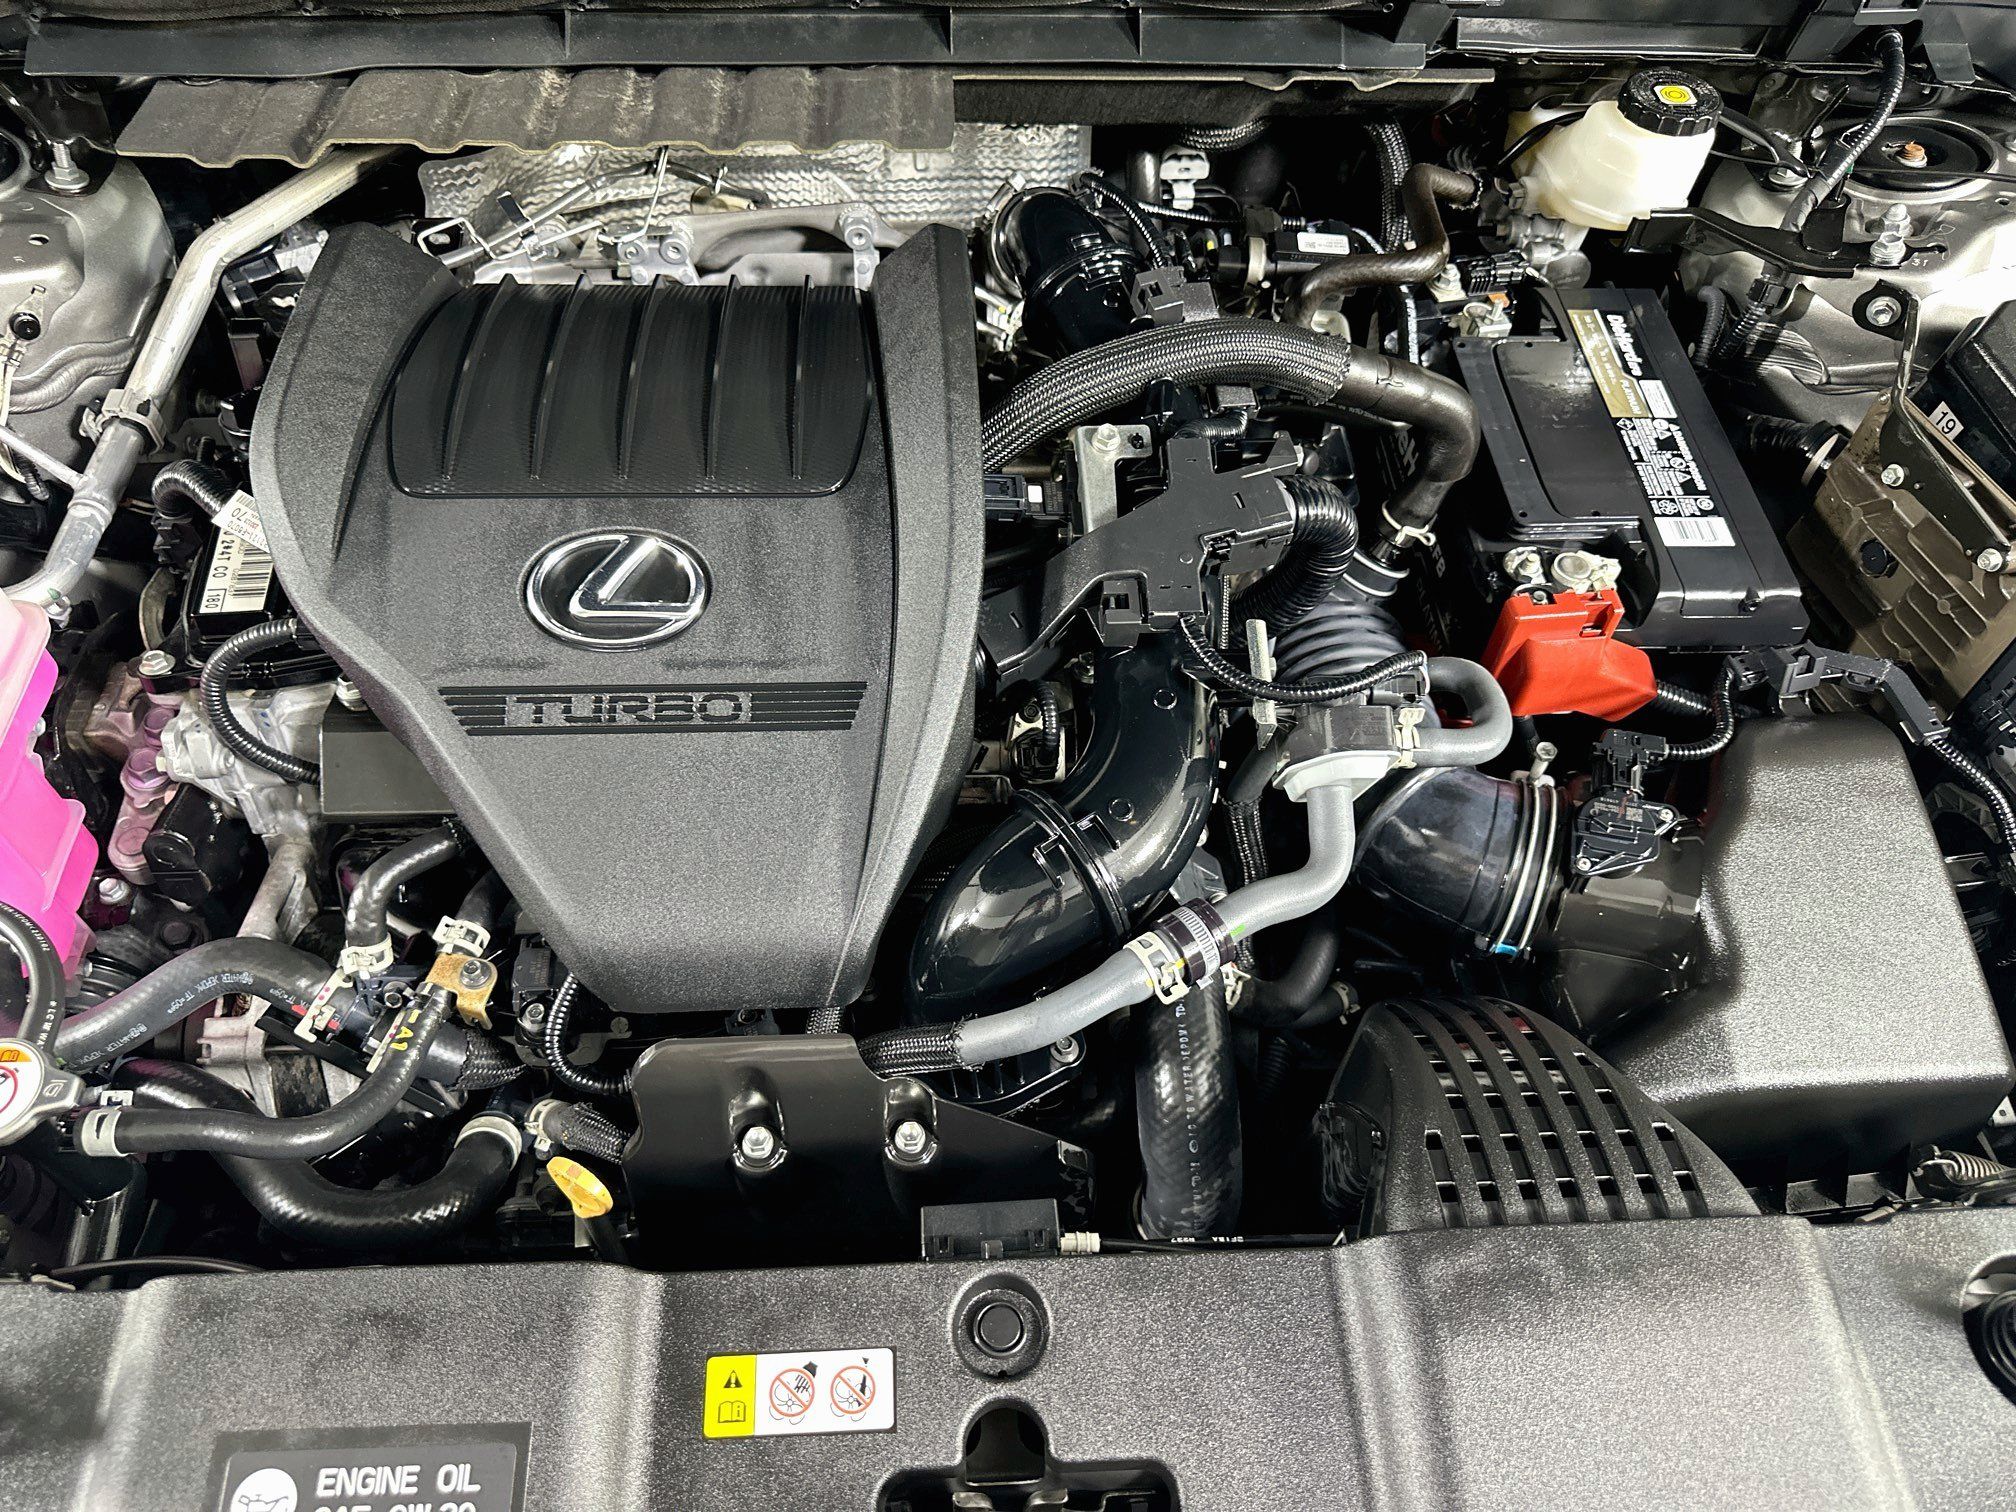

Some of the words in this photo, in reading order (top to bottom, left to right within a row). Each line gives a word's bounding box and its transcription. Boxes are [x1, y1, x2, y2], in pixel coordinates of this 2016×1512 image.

[1620, 379, 1642, 415] PLATINUM
[1935, 410, 1957, 435] 19
[515, 693, 742, 724] TURBO
[315, 1464, 421, 1498] ENGINE
[437, 1463, 481, 1493] OIL
